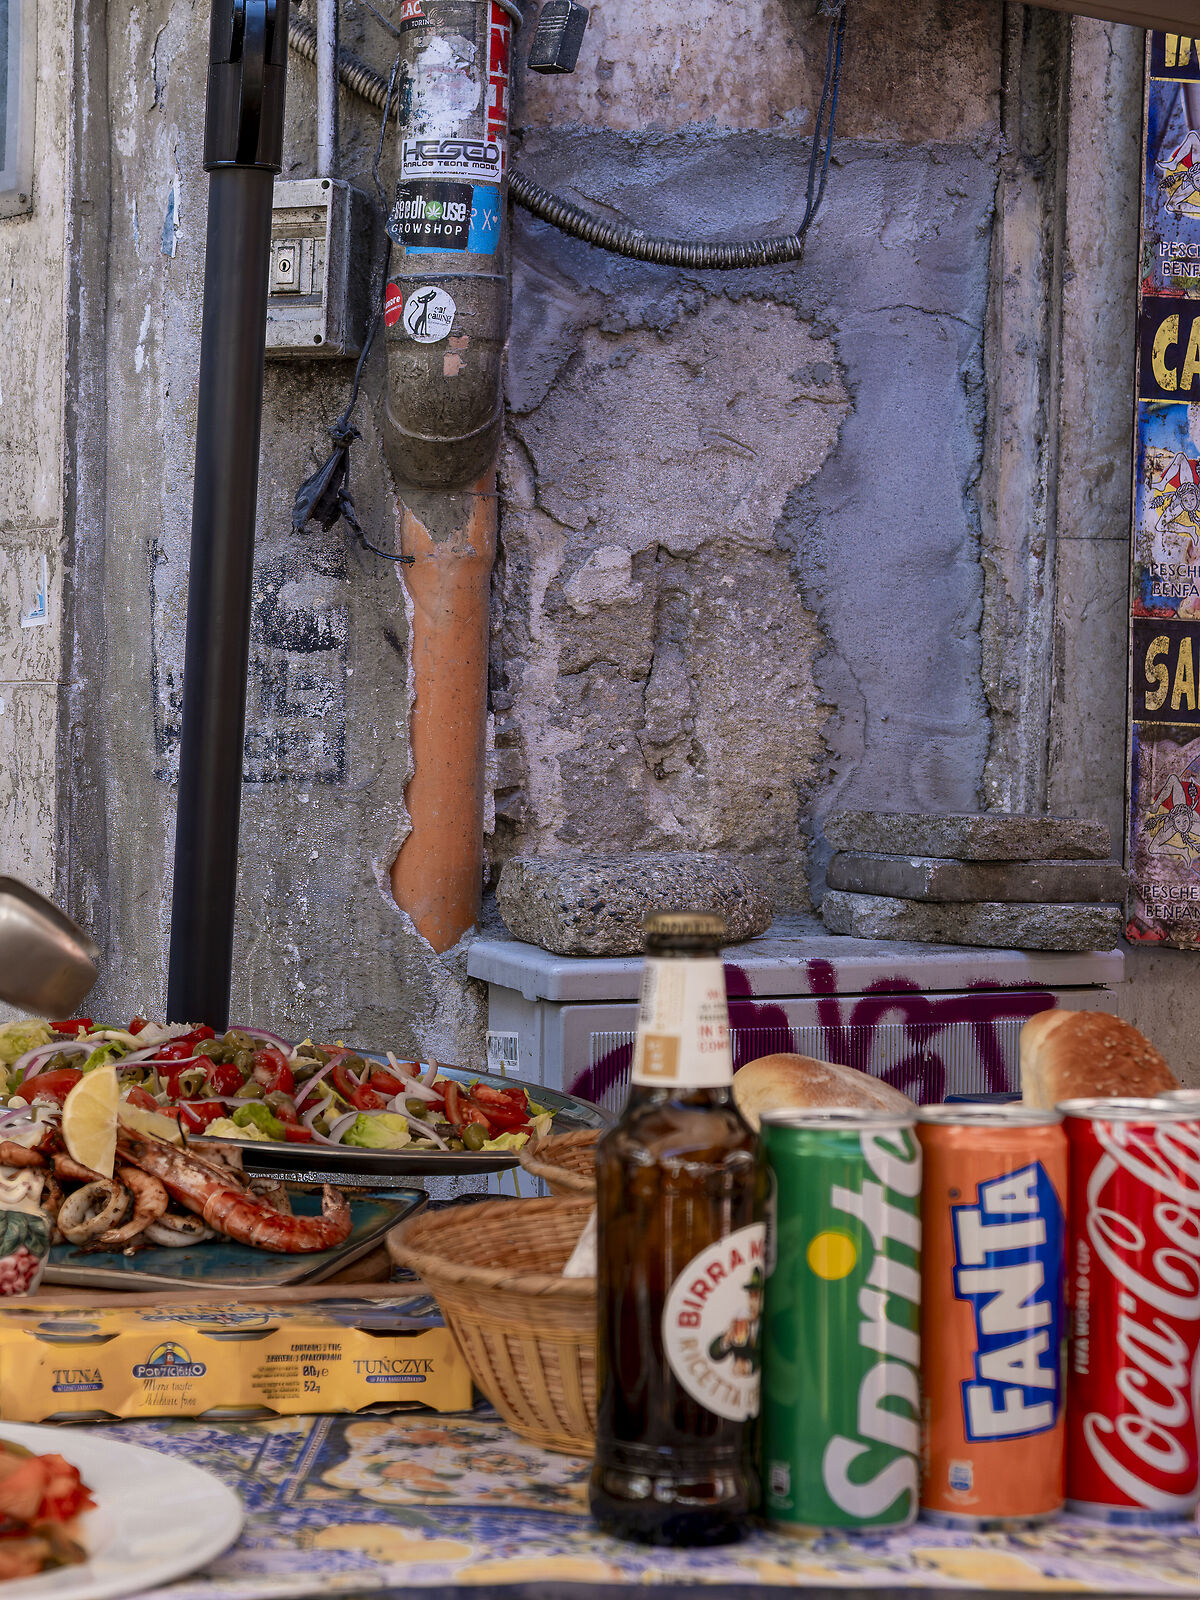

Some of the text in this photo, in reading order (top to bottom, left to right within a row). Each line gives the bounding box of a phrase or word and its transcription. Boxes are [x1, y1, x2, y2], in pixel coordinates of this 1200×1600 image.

[472, 162, 500, 172] MODEL
[391, 221, 463, 236] GROWSHOP
[1159, 241, 1200, 258] PESC
[1162, 260, 1200, 277] BENF
[1150, 562, 1200, 578] PESCH
[1144, 635, 1200, 711] SA
[678, 1247, 745, 1329] BIRRA
[956, 1164, 1057, 1438] FANTA
[352, 1356, 435, 1374] TUŃCZYK
[52, 1368, 103, 1384] TUNA
